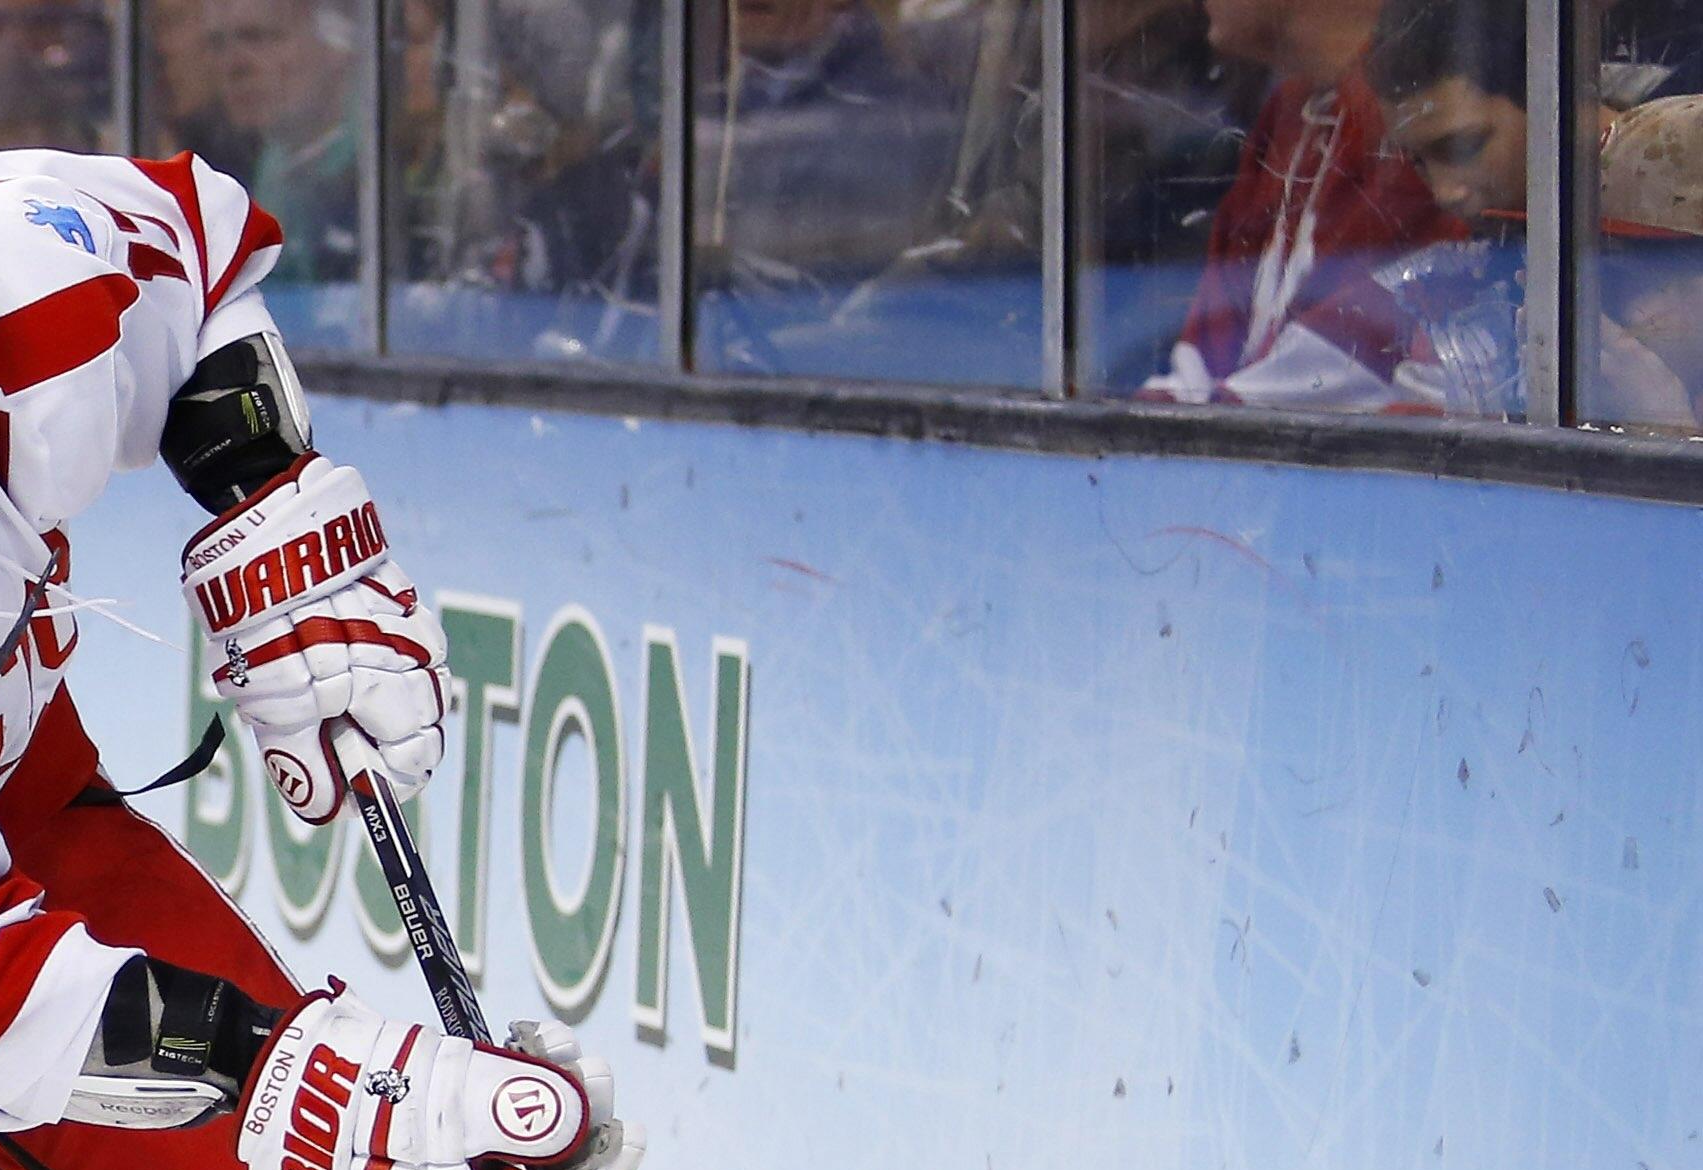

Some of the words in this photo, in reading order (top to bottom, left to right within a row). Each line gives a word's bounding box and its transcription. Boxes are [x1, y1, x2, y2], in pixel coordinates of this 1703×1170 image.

[189, 528, 246, 570] BOSTON
[246, 508, 266, 527] U
[195, 500, 390, 633] WARRIO
[365, 804, 388, 843] MX3
[394, 883, 434, 961] BAUER
[245, 1050, 296, 1135] BOSTON
[284, 1026, 304, 1041] U
